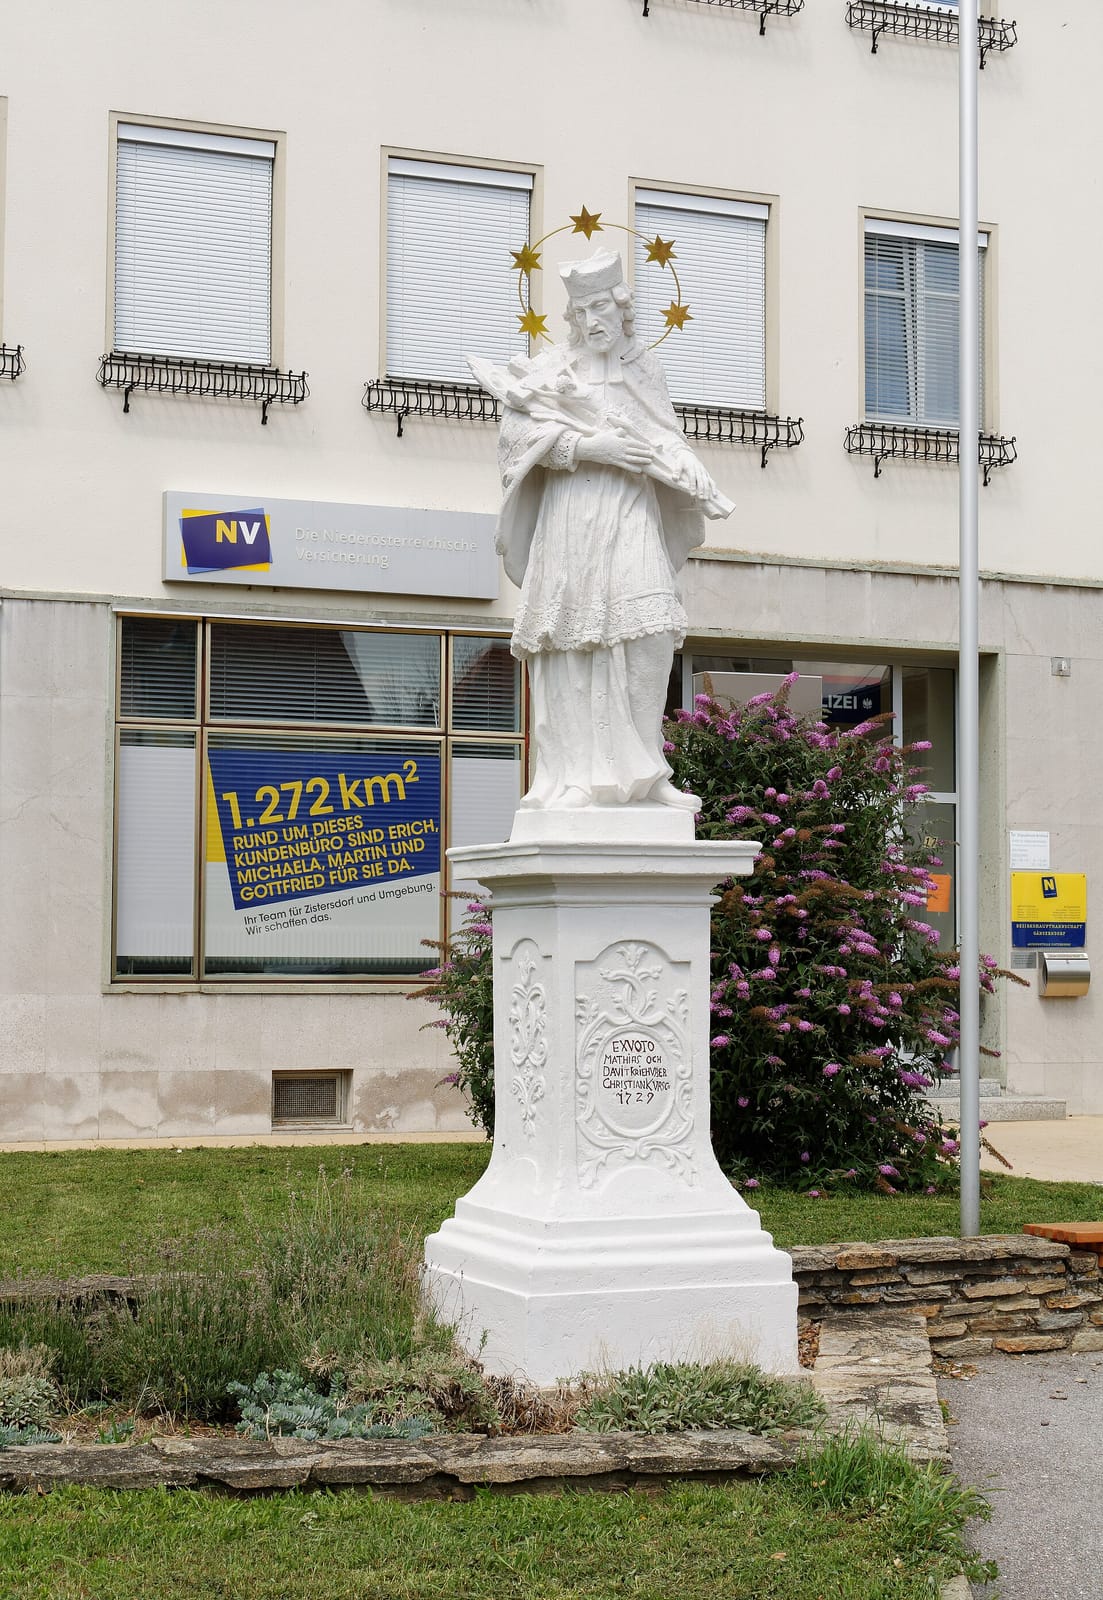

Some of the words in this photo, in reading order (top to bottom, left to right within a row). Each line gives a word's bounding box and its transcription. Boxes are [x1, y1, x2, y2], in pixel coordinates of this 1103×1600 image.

[215, 519, 261, 545] NV
[295, 527, 319, 541] Die
[323, 528, 478, 553] Niederösterreichische
[296, 546, 390, 569] Versicherung
[222, 777, 334, 830] 1.272
[233, 831, 278, 850] RUND
[282, 824, 309, 841] UM
[312, 815, 363, 837] DIESES
[234, 836, 343, 867] KUNDENBÜRO
[347, 828, 385, 847] SIND
[388, 819, 439, 839] ERICH,
[237, 857, 325, 885] MICHAELA,
[327, 844, 388, 868] MARTIN
[391, 838, 425, 856] UND
[240, 873, 326, 901] GOTTFRIED
[329, 865, 359, 885] FÜR
[361, 862, 385, 879] SIE
[387, 857, 415, 874] DA.
[244, 915, 257, 926] Ihr
[258, 911, 287, 923] Team
[289, 906, 303, 917] für
[304, 895, 355, 914] Zistersdorf
[357, 892, 376, 904] und
[378, 883, 437, 899] Umgebung.
[245, 925, 262, 936] Wir
[265, 917, 308, 933] schaffen
[310, 913, 332, 924] das.
[646, 1055, 662, 1064] OCH
[616, 1090, 655, 1104] 1729
